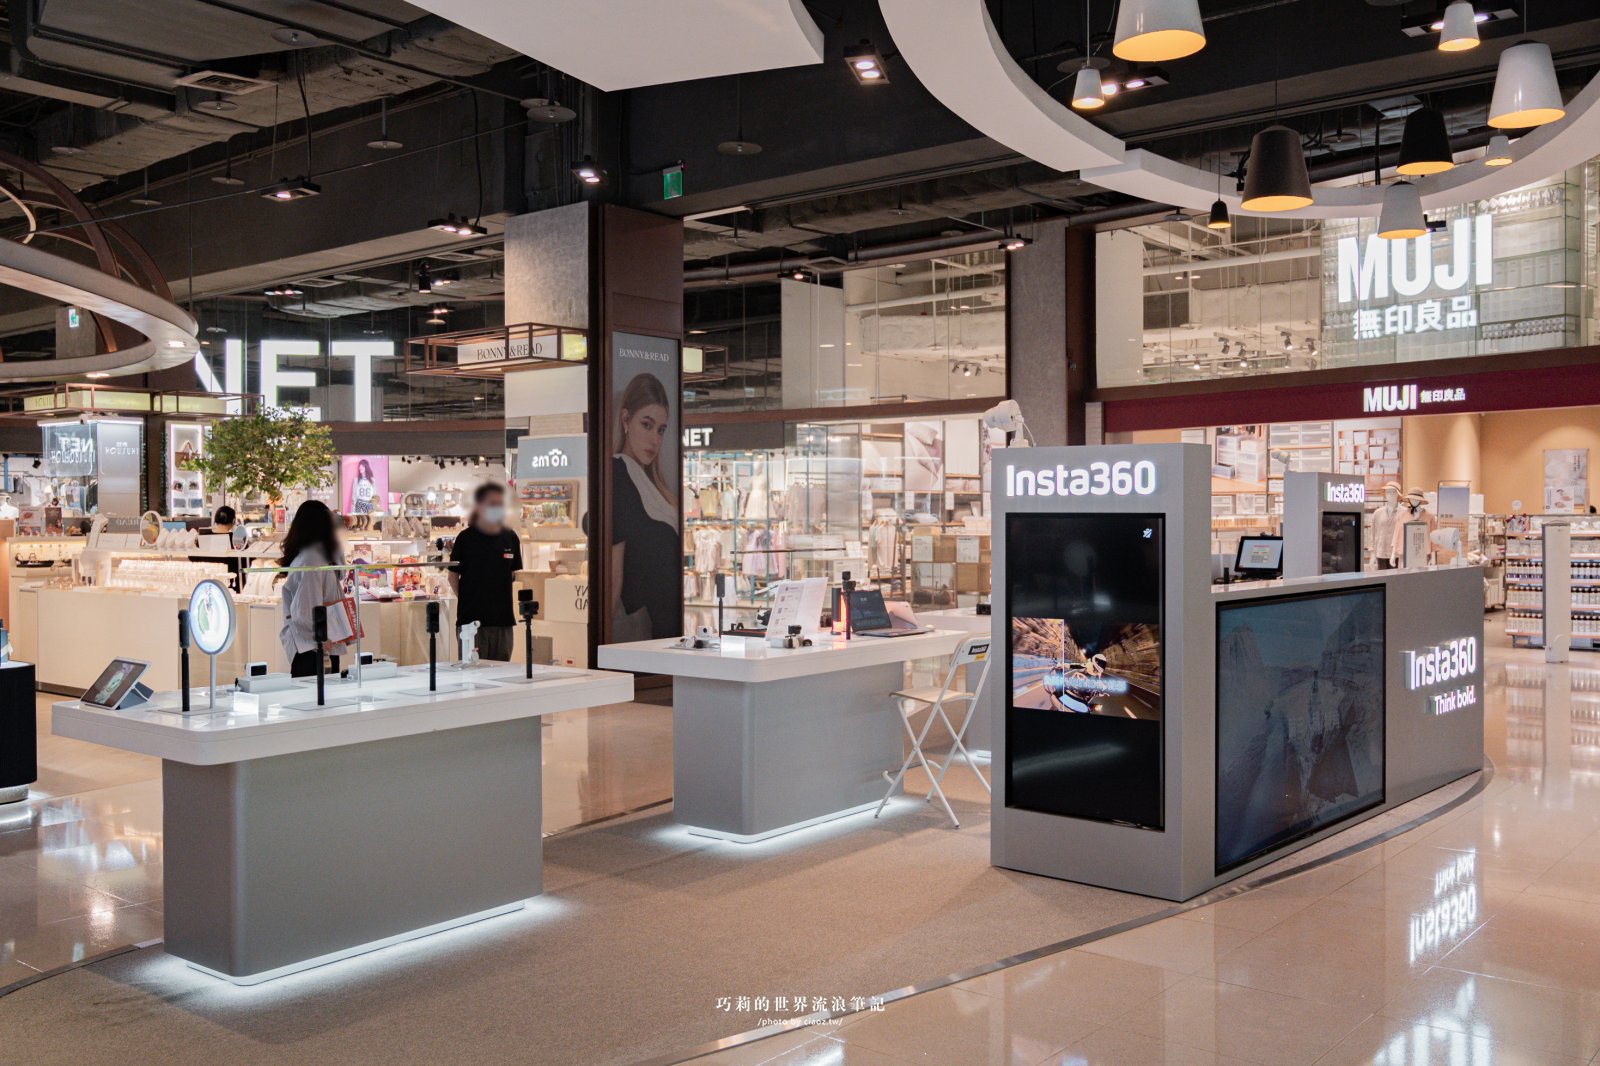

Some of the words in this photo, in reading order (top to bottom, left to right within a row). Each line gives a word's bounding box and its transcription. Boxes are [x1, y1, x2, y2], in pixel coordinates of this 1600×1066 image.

[1338, 214, 1493, 303] MUJI
[1353, 295, 1477, 340] 無印良品
[619, 348, 670, 362] BONNY&READ
[1363, 384, 1418, 412] MUJI
[1420, 387, 1466, 403] 無印良品
[1006, 460, 1156, 496] Insta360
[1327, 481, 1365, 503] Insta360
[1409, 636, 1477, 690] Insta360
[1434, 691, 1456, 715] Think
[1457, 685, 1477, 708] bold.
